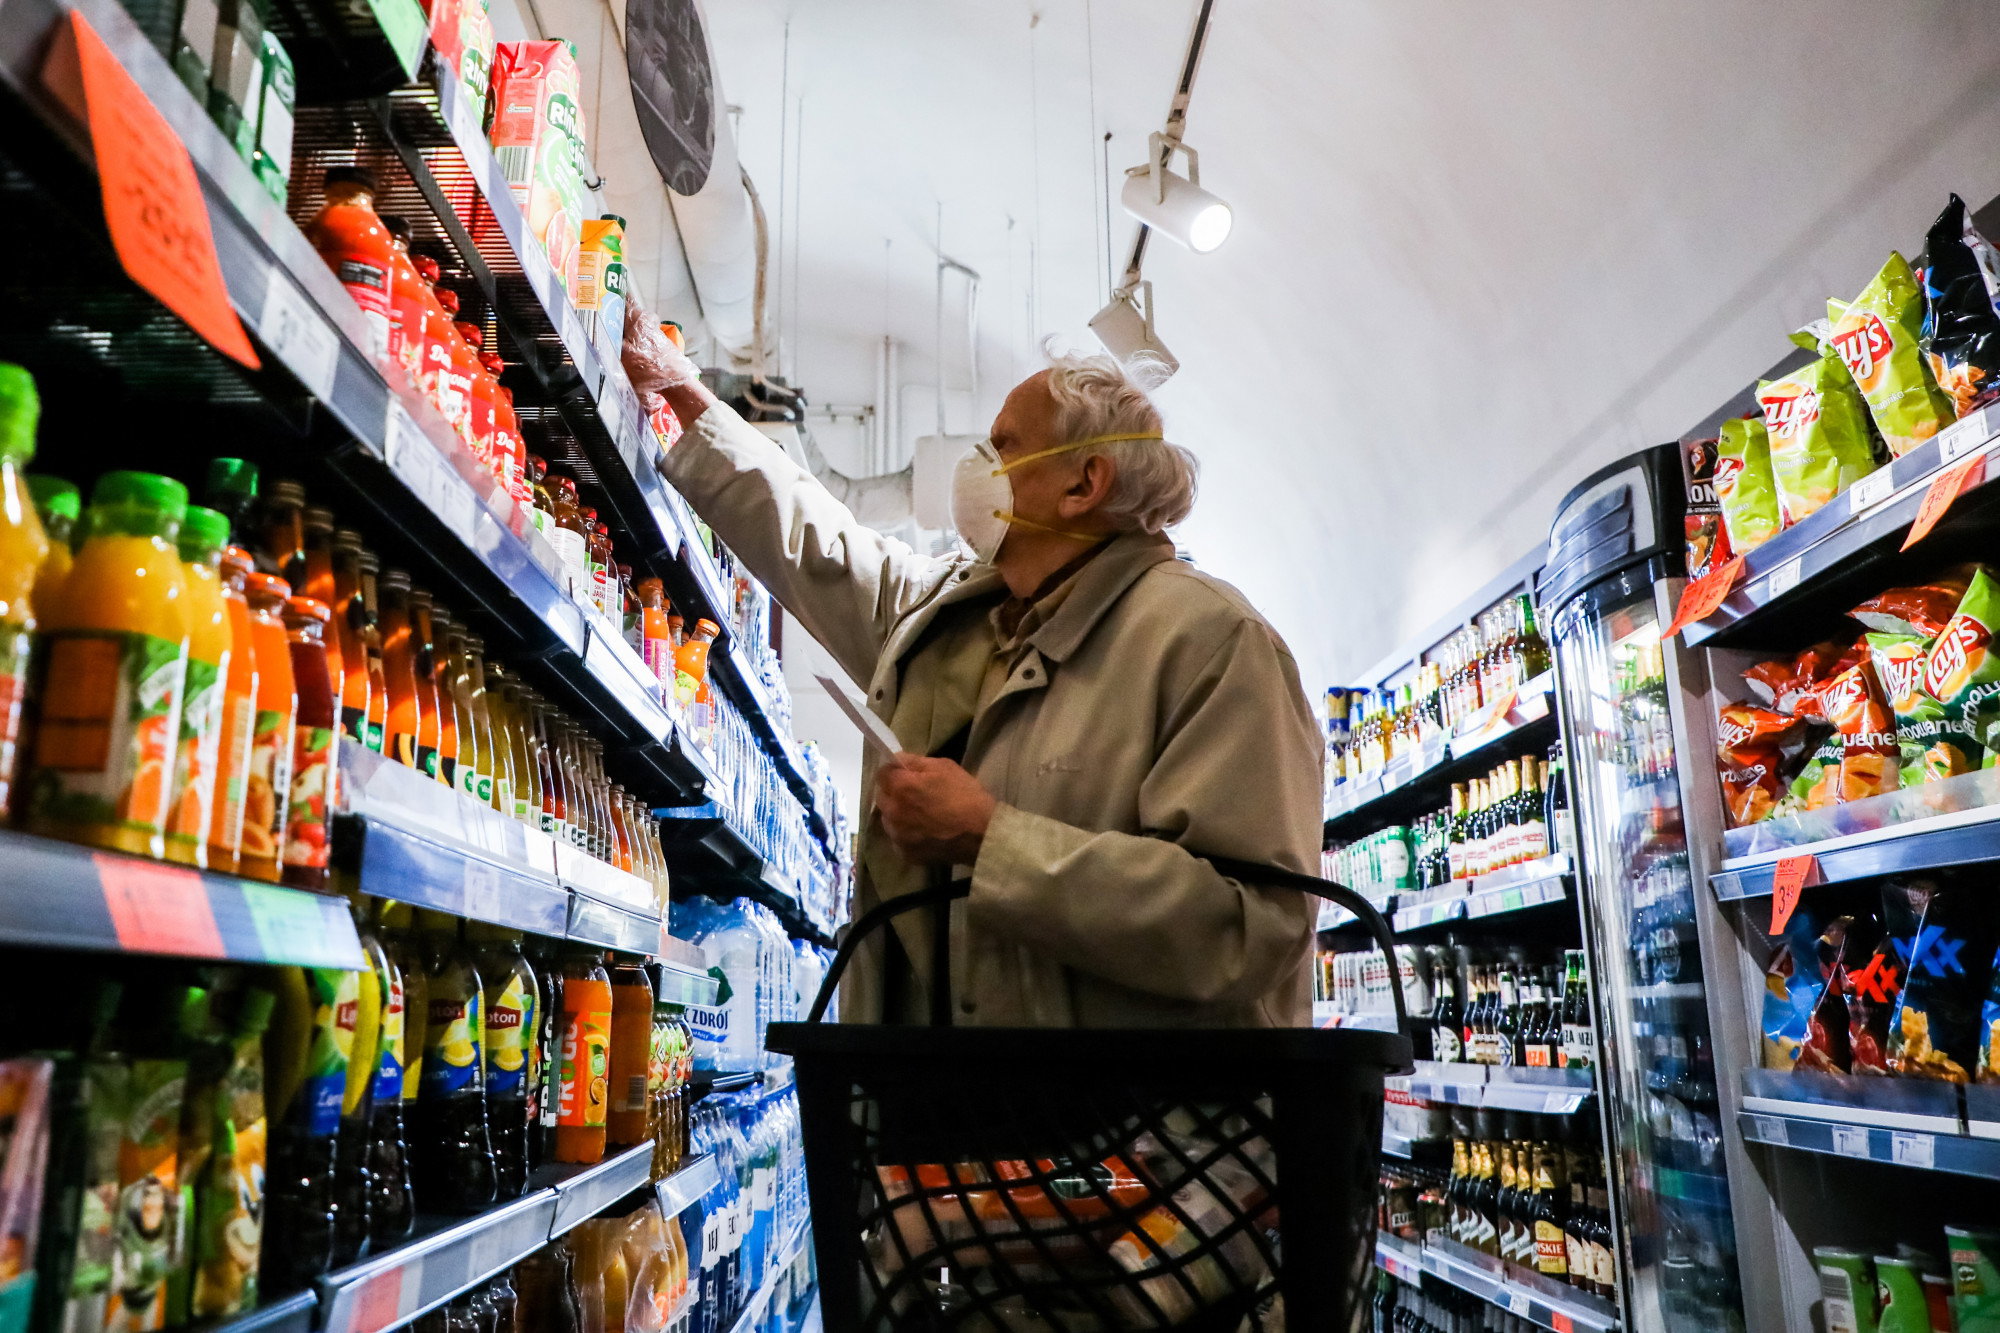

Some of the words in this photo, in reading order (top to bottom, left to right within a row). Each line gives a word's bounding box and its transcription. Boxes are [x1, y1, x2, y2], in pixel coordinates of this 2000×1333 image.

[1949, 438, 1955, 456] 4
[1859, 487, 1866, 504] 4
[1928, 621, 1978, 696] Lay's
[1778, 886, 1786, 914] 3
[691, 1008, 729, 1030] ZDRÓJ
